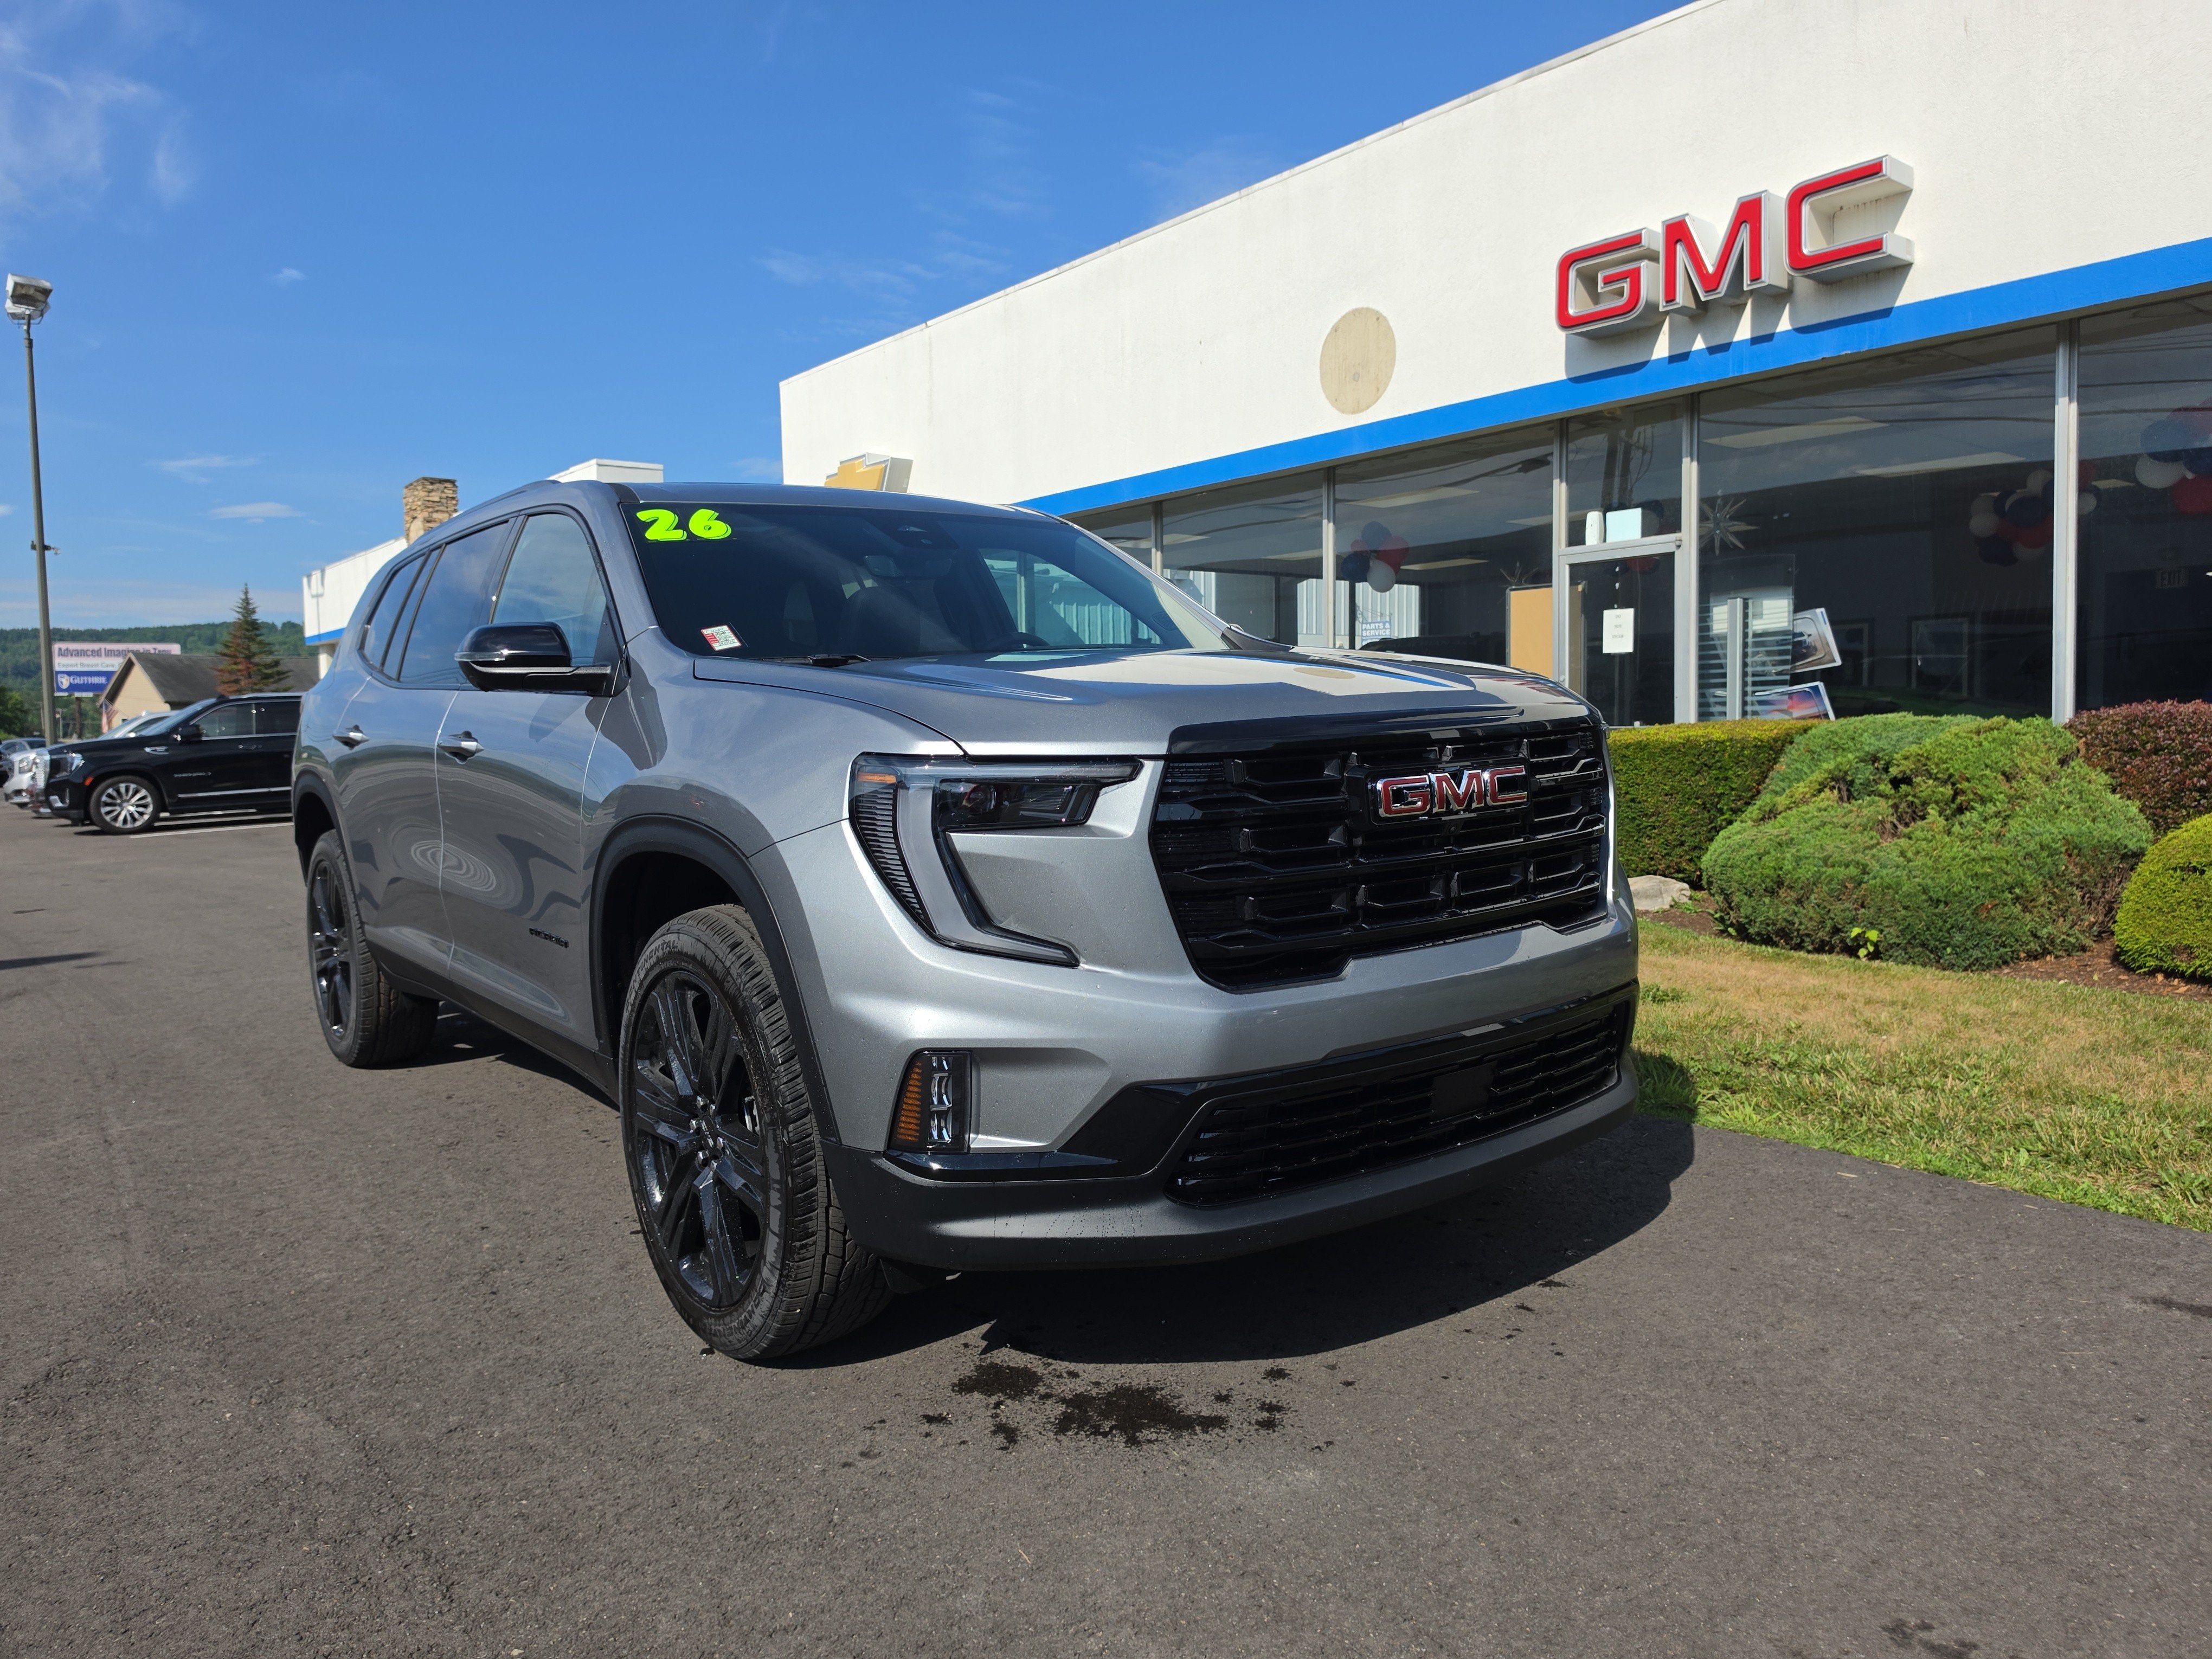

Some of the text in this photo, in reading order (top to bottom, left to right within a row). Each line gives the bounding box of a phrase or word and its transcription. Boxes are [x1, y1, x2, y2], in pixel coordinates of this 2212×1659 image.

[1555, 155, 1901, 334] GMC
[636, 508, 732, 542] 26
[2160, 571, 2183, 587] EXIT
[57, 647, 102, 657] Advanced
[104, 647, 140, 659] Imag
[70, 674, 108, 684] GUTHRIE
[1377, 765, 1527, 817] GMC
